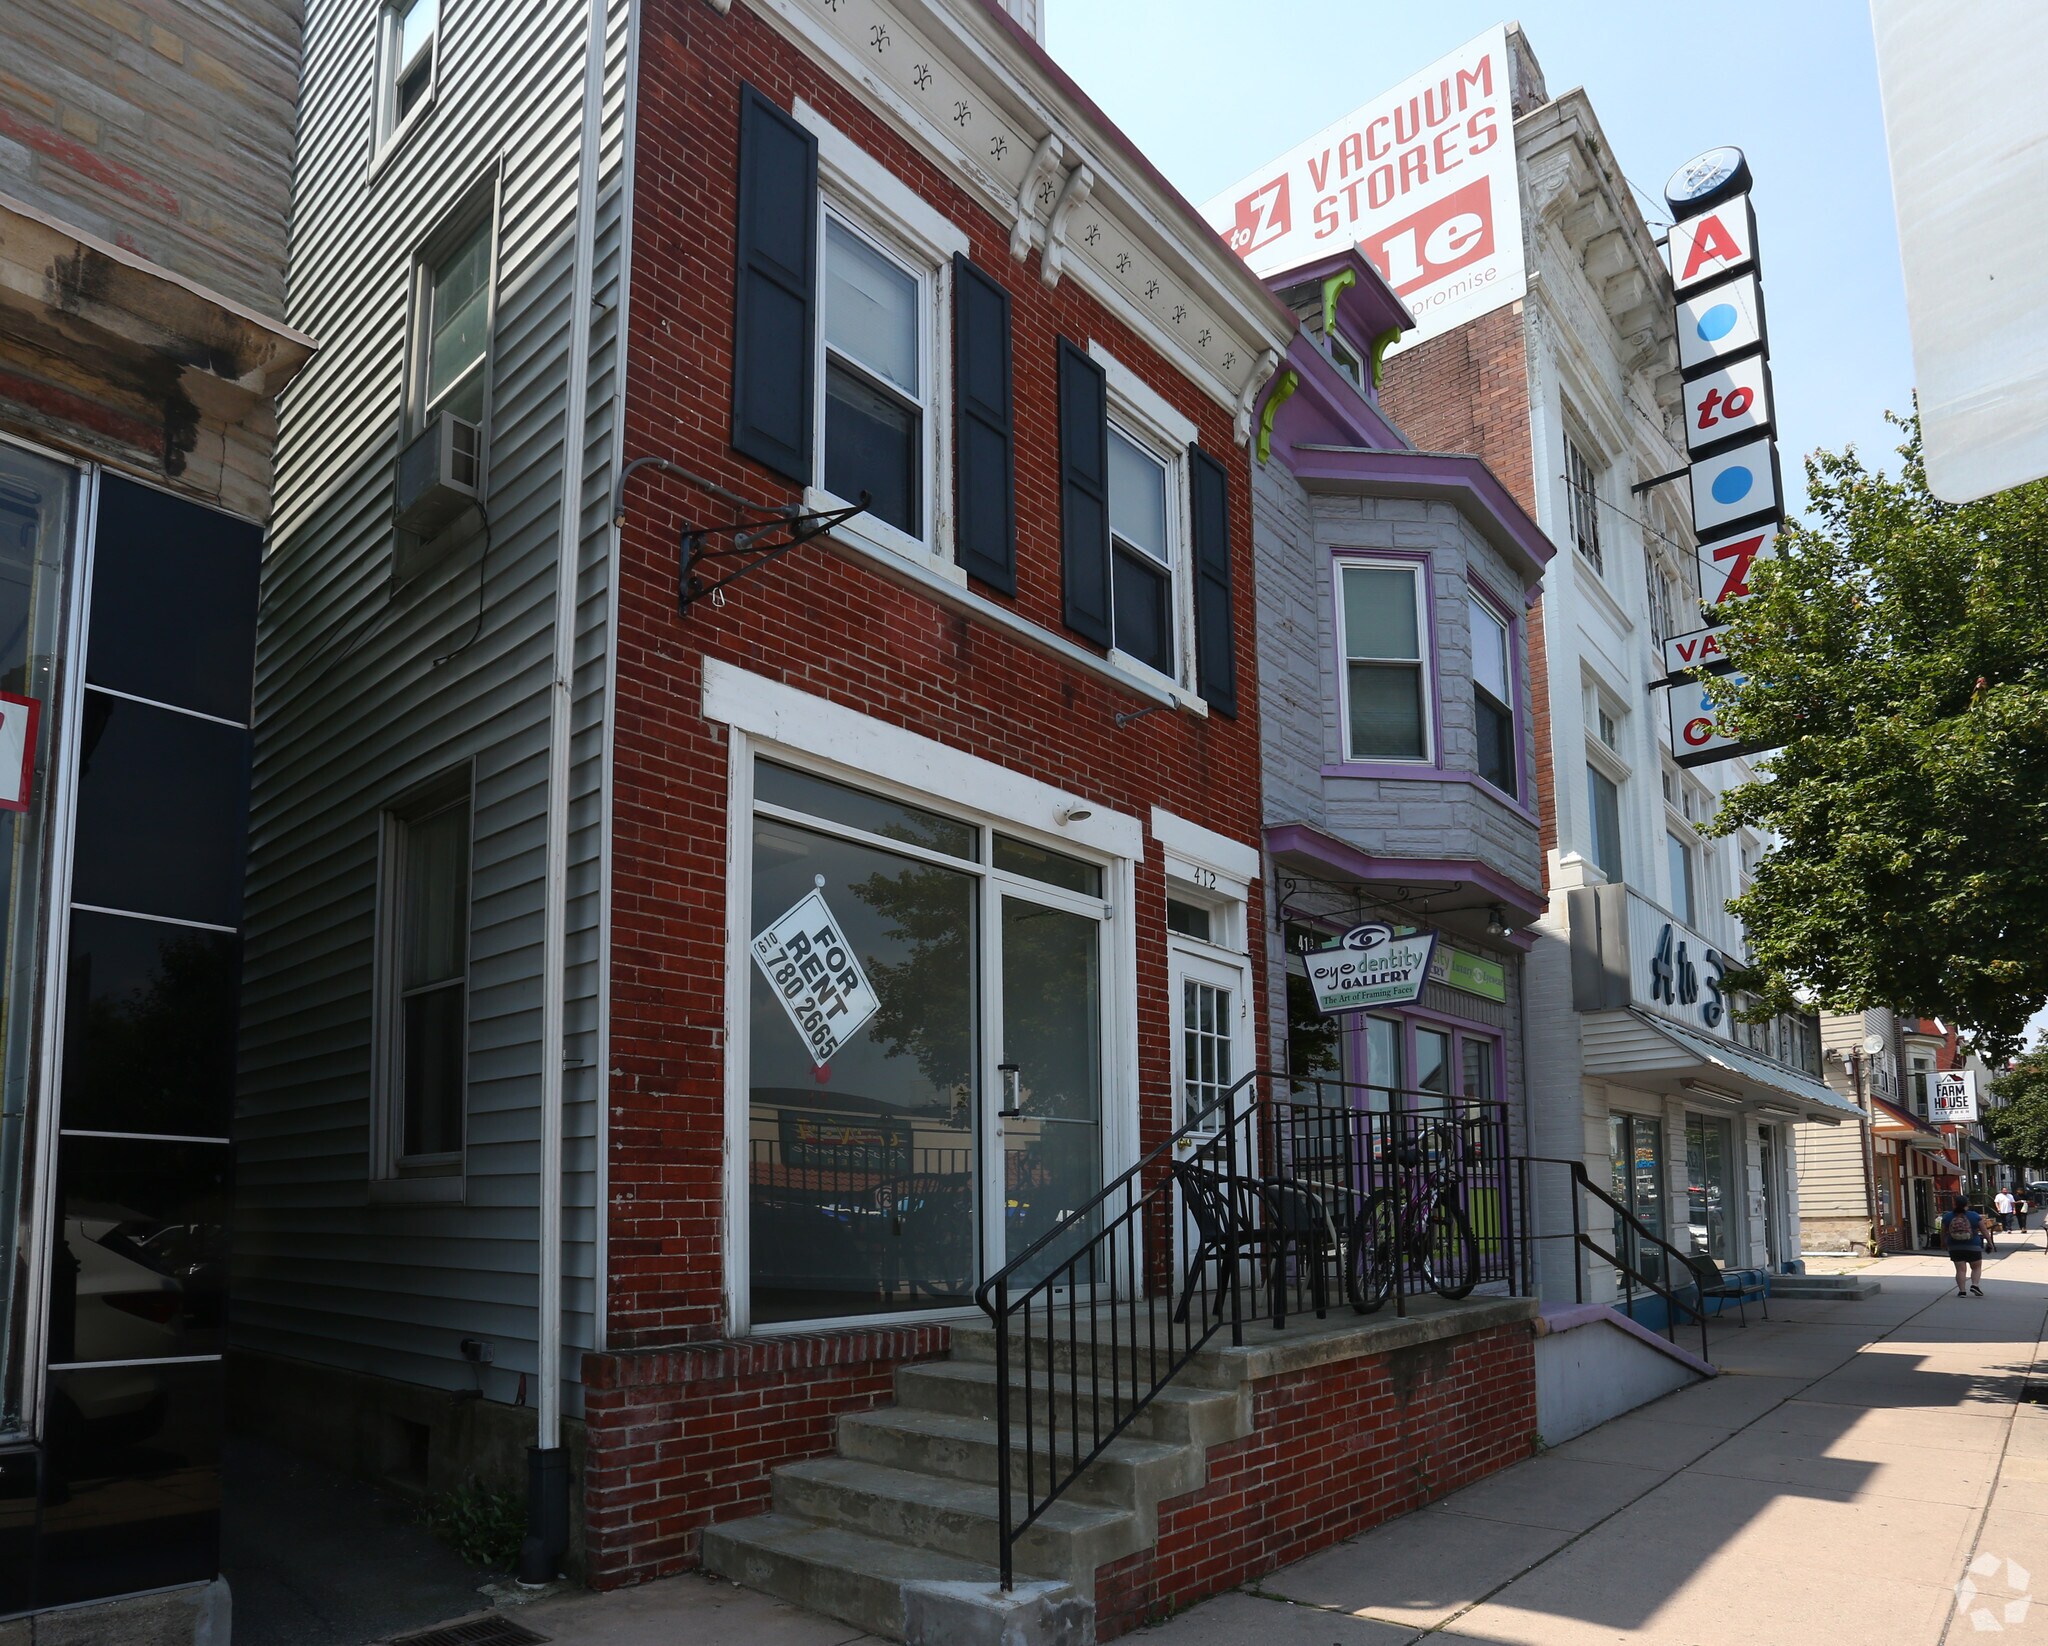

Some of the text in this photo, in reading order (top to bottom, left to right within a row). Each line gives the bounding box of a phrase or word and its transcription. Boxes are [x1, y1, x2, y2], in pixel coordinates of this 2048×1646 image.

[1307, 54, 1493, 193] VACUUM
[1313, 107, 1497, 240] STORES
[1231, 183, 1283, 251] to Z
[1681, 214, 1743, 281] A
[1412, 267, 1497, 317] promise
[1697, 387, 1754, 429] to
[1712, 533, 1766, 604] Z
[1194, 867, 1216, 890] 412
[758, 932, 778, 953] 610
[785, 930, 849, 1021] RENT
[812, 925, 859, 997] FOR
[767, 947, 839, 1059] 780 2665
[1324, 986, 1413, 1005] The Art of Framing Faces
[1341, 969, 1411, 990] GALLERY
[1936, 1084, 1965, 1097] FARM
